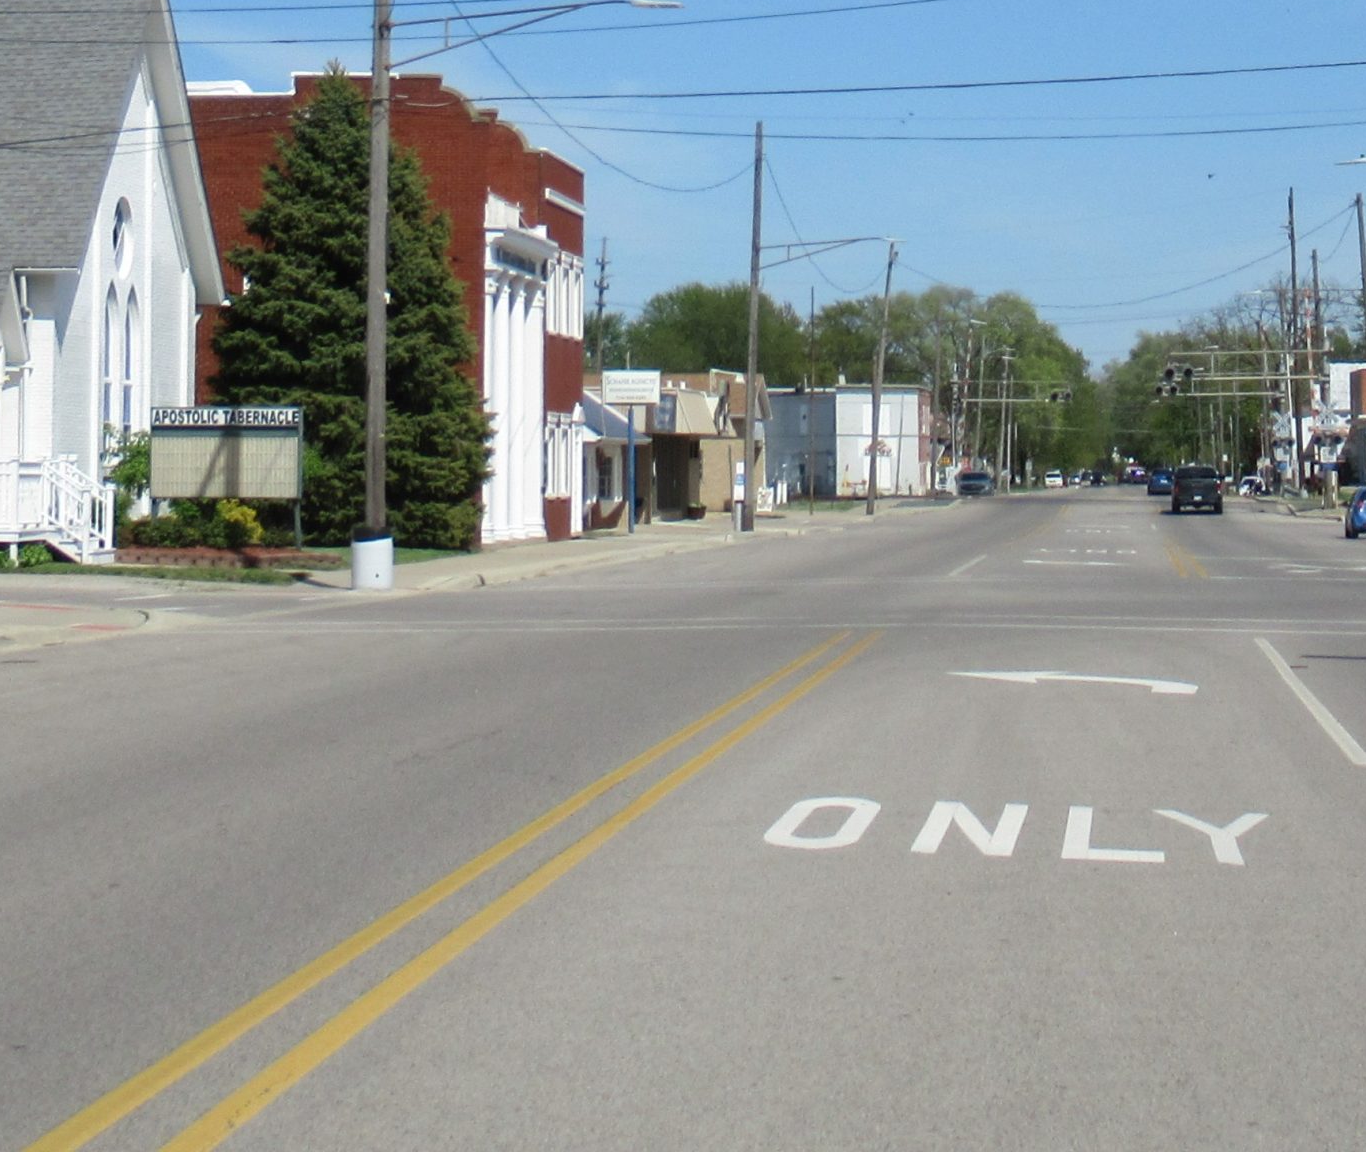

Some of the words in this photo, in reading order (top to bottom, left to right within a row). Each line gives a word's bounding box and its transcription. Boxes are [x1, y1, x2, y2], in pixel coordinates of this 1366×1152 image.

[153, 410, 219, 424] APOSTOLIC
[222, 409, 299, 425] TABERNACLE
[763, 796, 1269, 866] ONLY
